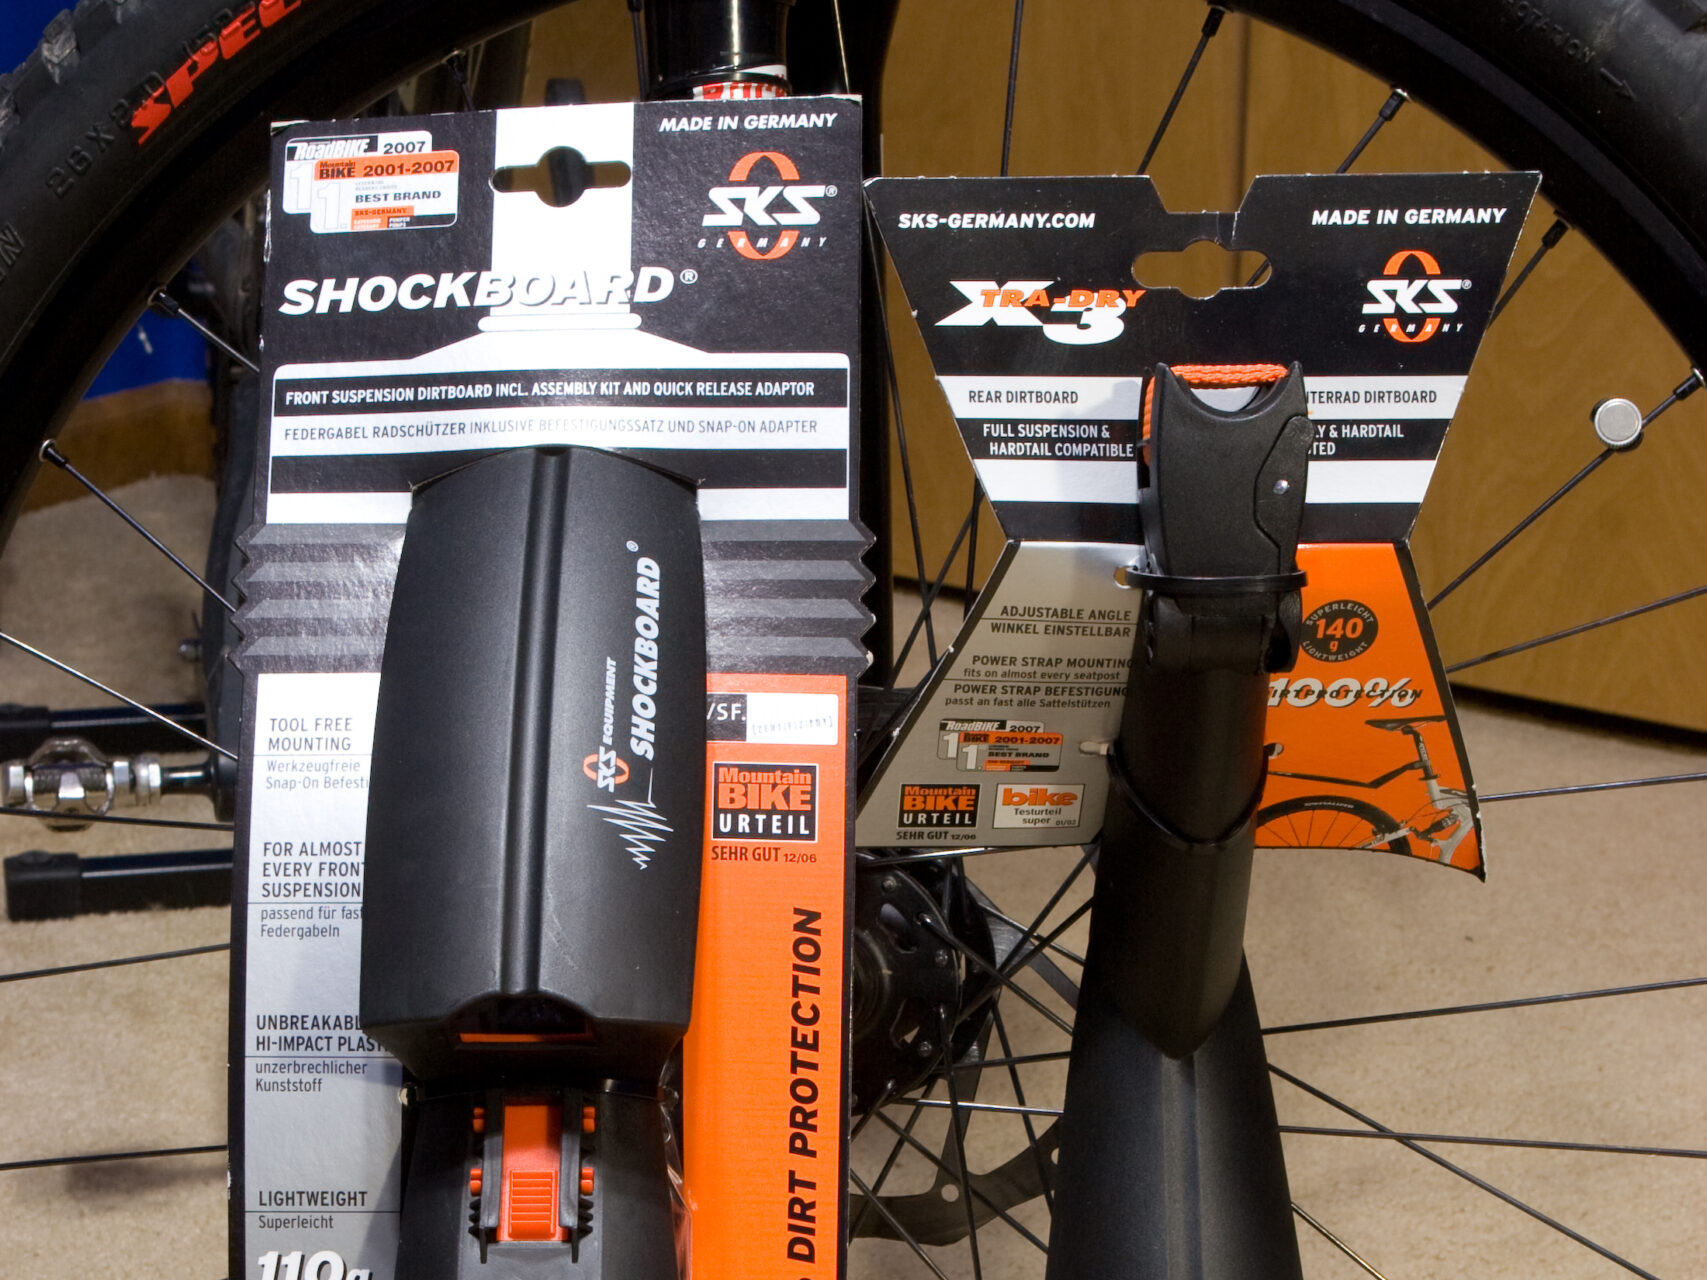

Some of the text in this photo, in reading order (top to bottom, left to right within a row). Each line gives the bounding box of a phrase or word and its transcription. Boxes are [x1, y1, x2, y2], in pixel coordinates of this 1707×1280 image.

[659, 113, 838, 132] MADE IN GERMANY
[383, 141, 426, 155] 2007
[319, 160, 454, 180] BIKE 2001-2007
[355, 190, 441, 203] BEST BRAND
[898, 213, 1096, 229] SKS-GERMANY.COM
[1311, 208, 1507, 225] MADE IN GERMANY
[278, 266, 676, 316] SHOCKBOARD
[285, 381, 815, 405] FRONT SUSPENSION DIRTBOARD INCL. ASSEMBLY KIT AND QUICK RELEASE ADAPTOR
[968, 390, 1079, 404] REAR DIRTBOARD
[1306, 390, 1437, 404] TERRAD DIRTBOARD
[285, 419, 818, 441] FEDERGABEL RADSCHÜTZER INKLUSIVE BEFESTIGUNGSSATZ UND SNAP-ON ADAPTER
[983, 424, 1110, 438] FULL SUSPENSION &
[1329, 424, 1404, 438] & HARDTAIL
[989, 442, 1134, 457] HARDTAIL COMPATIBLE
[1000, 605, 1132, 621] ADJUSTABLE ANGLE
[1306, 602, 1375, 626] SUPERLEICHT
[991, 622, 1131, 637] WINKEL EINSTELLBAR
[1315, 617, 1363, 639] 140
[1302, 640, 1368, 662] LIGHTWEIGHT
[630, 557, 661, 761] SHOCKBOARD
[972, 655, 1017, 667] POWER
[1021, 656, 1063, 668] STRAP
[963, 667, 1121, 682] fits on almost every seatpost
[954, 684, 997, 695] POWER
[1001, 685, 1041, 696] STRAP
[1267, 677, 1413, 708] 100%
[602, 656, 617, 746] EQUIPMENT
[945, 697, 1111, 709] passt an fast alle Sattelstützen
[269, 718, 353, 732] TOOL FREE
[1009, 724, 1041, 733] 2007
[268, 737, 351, 751] MOUNTING
[994, 735, 1060, 745] 2001-2007
[266, 760, 360, 775] Werkzeugfreie
[718, 767, 812, 784] Mountain
[266, 776, 369, 791] Snap-On Befesti
[904, 786, 976, 796] Mountain
[718, 784, 812, 811] BIKE
[903, 796, 976, 811] BIKE
[1002, 788, 1078, 806] bike
[903, 813, 972, 825] URTEIL
[1014, 807, 1062, 816] Testurteil
[718, 814, 810, 835] URTEIL
[1022, 816, 1051, 825] super
[896, 831, 925, 840] SEHR
[927, 831, 950, 840] GUT
[263, 841, 362, 857] FOR ALMOST
[711, 845, 817, 864] SEHR GUT 12/06
[262, 862, 312, 877] EVERY
[261, 883, 362, 898] SUSPENSION
[260, 907, 314, 922] passend
[317, 905, 337, 920] für
[260, 924, 340, 940] Federgabeln
[256, 1015, 362, 1031] UNBREAKABL
[789, 907, 822, 1159] PROTECTION
[256, 1036, 332, 1052] HI-IMPACT
[255, 1060, 368, 1075] unzerbrechlicher
[255, 1078, 322, 1093] Kunststoff
[258, 1191, 368, 1207] LIGHTWEIGHT
[258, 1215, 334, 1231] Superleicht
[787, 1169, 817, 1264] DIRT
